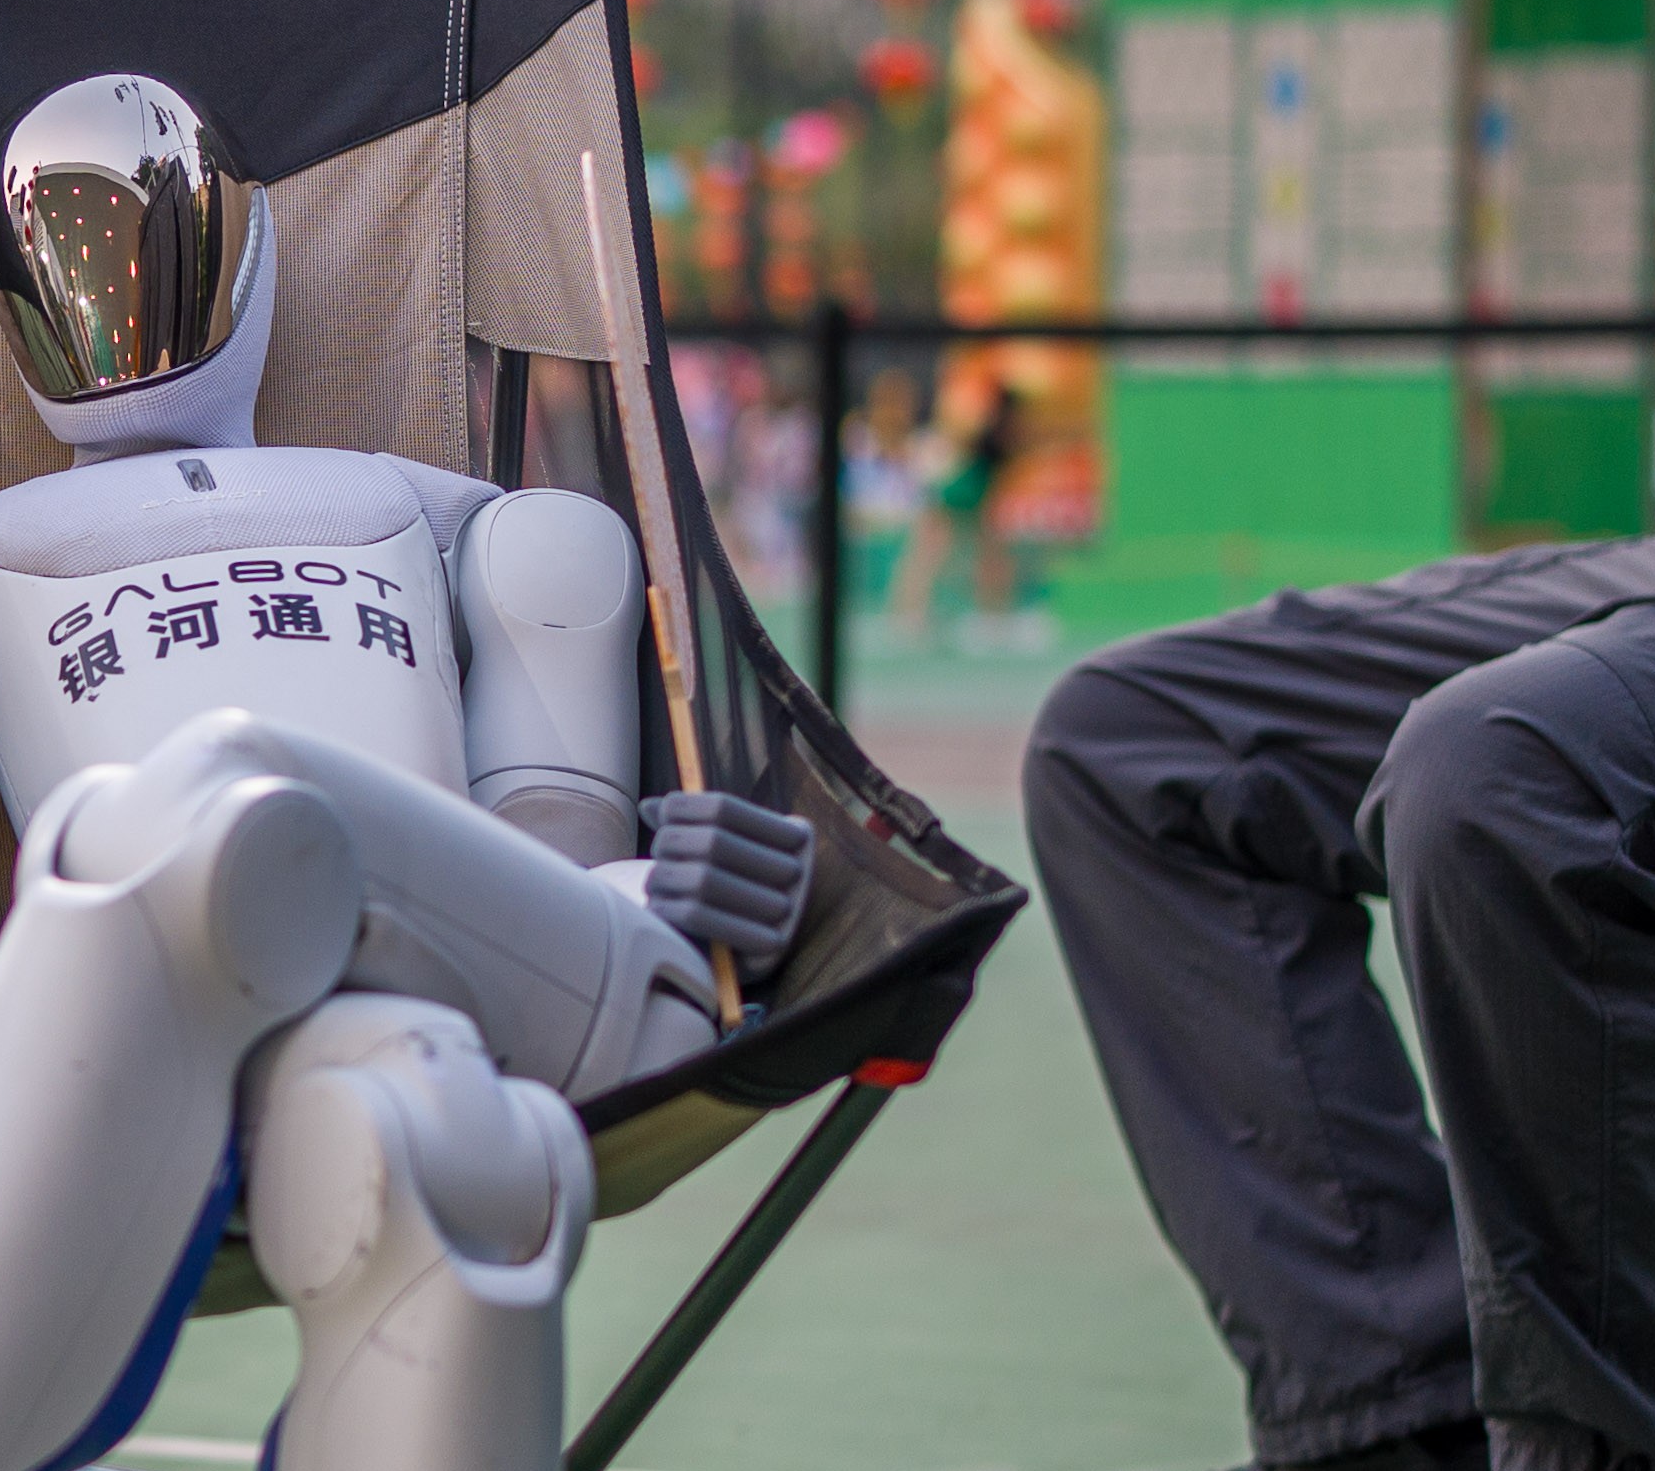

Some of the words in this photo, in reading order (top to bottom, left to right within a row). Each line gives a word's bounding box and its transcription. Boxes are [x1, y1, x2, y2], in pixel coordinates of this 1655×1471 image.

[48, 560, 402, 647] GALBOT
[58, 593, 417, 704] 银河通用
